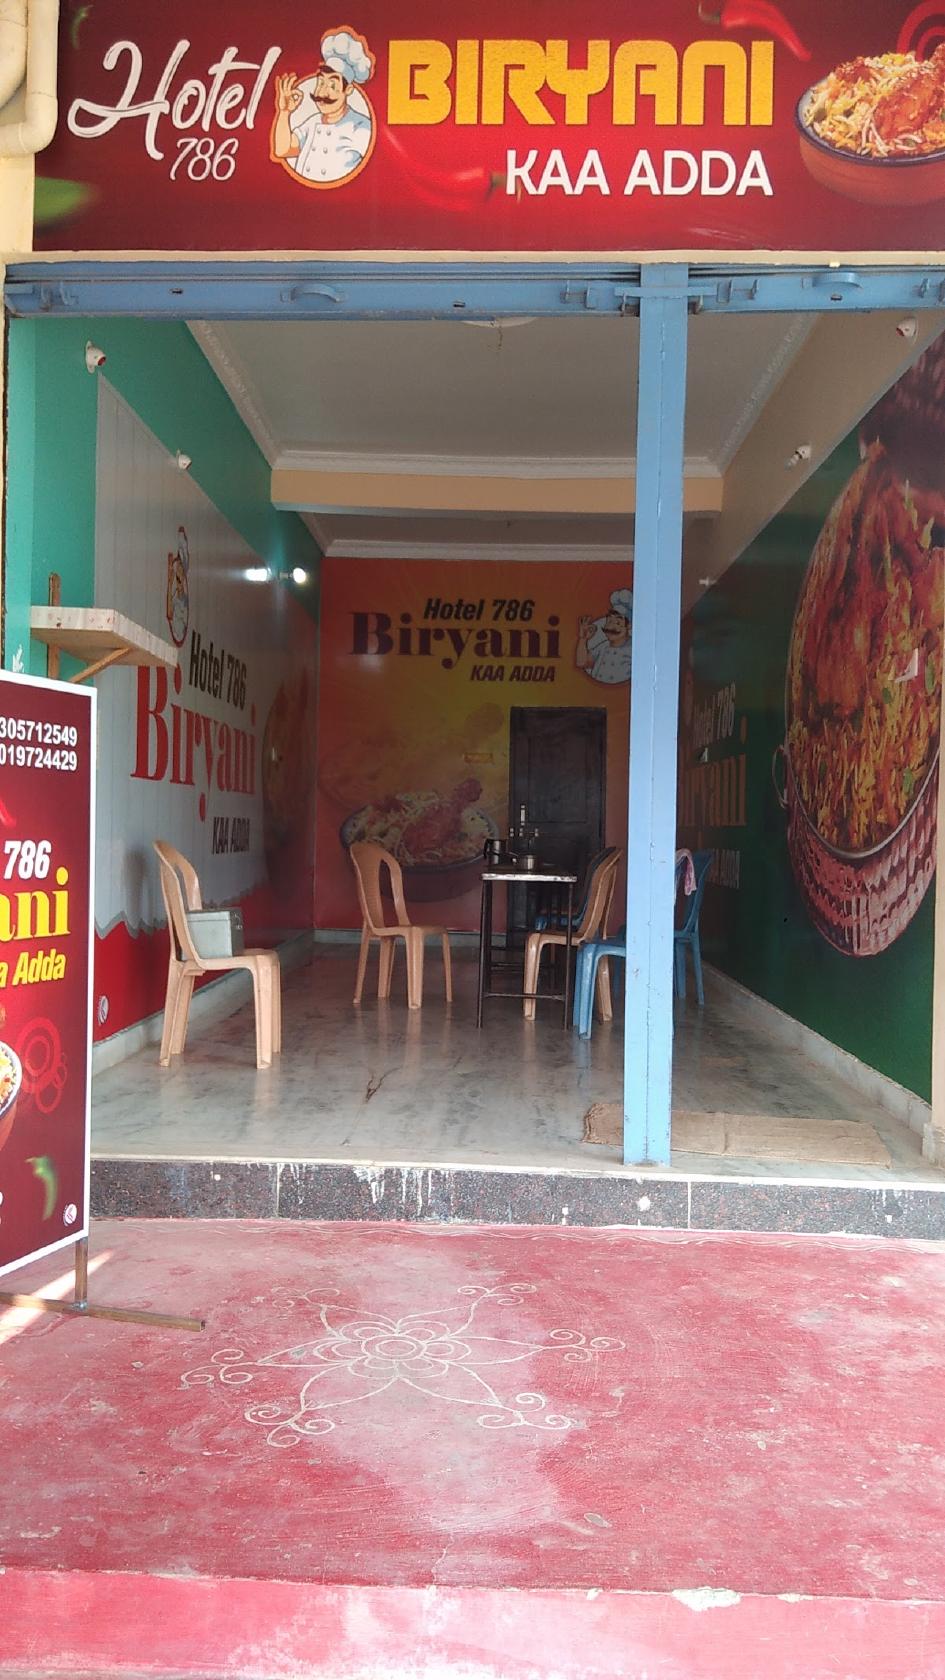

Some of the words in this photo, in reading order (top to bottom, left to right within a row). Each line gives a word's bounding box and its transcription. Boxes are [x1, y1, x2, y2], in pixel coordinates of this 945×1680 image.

[67, 39, 282, 161] Hotel
[387, 39, 775, 126] BIRYANI
[170, 137, 239, 181] 786
[505, 149, 611, 196] KAA
[623, 149, 774, 197] ADDA
[423, 598, 484, 621] Hotel
[491, 599, 535, 622] 786
[349, 611, 562, 670] Biryani
[188, 629, 225, 699] Hotel
[227, 653, 248, 711] 786
[470, 665, 504, 682] KAA
[508, 665, 555, 682] ADDA
[716, 682, 736, 739] 786
[130, 662, 257, 822] Biryani
[3, 839, 52, 880] 786
[12, 948, 67, 986] Adda
